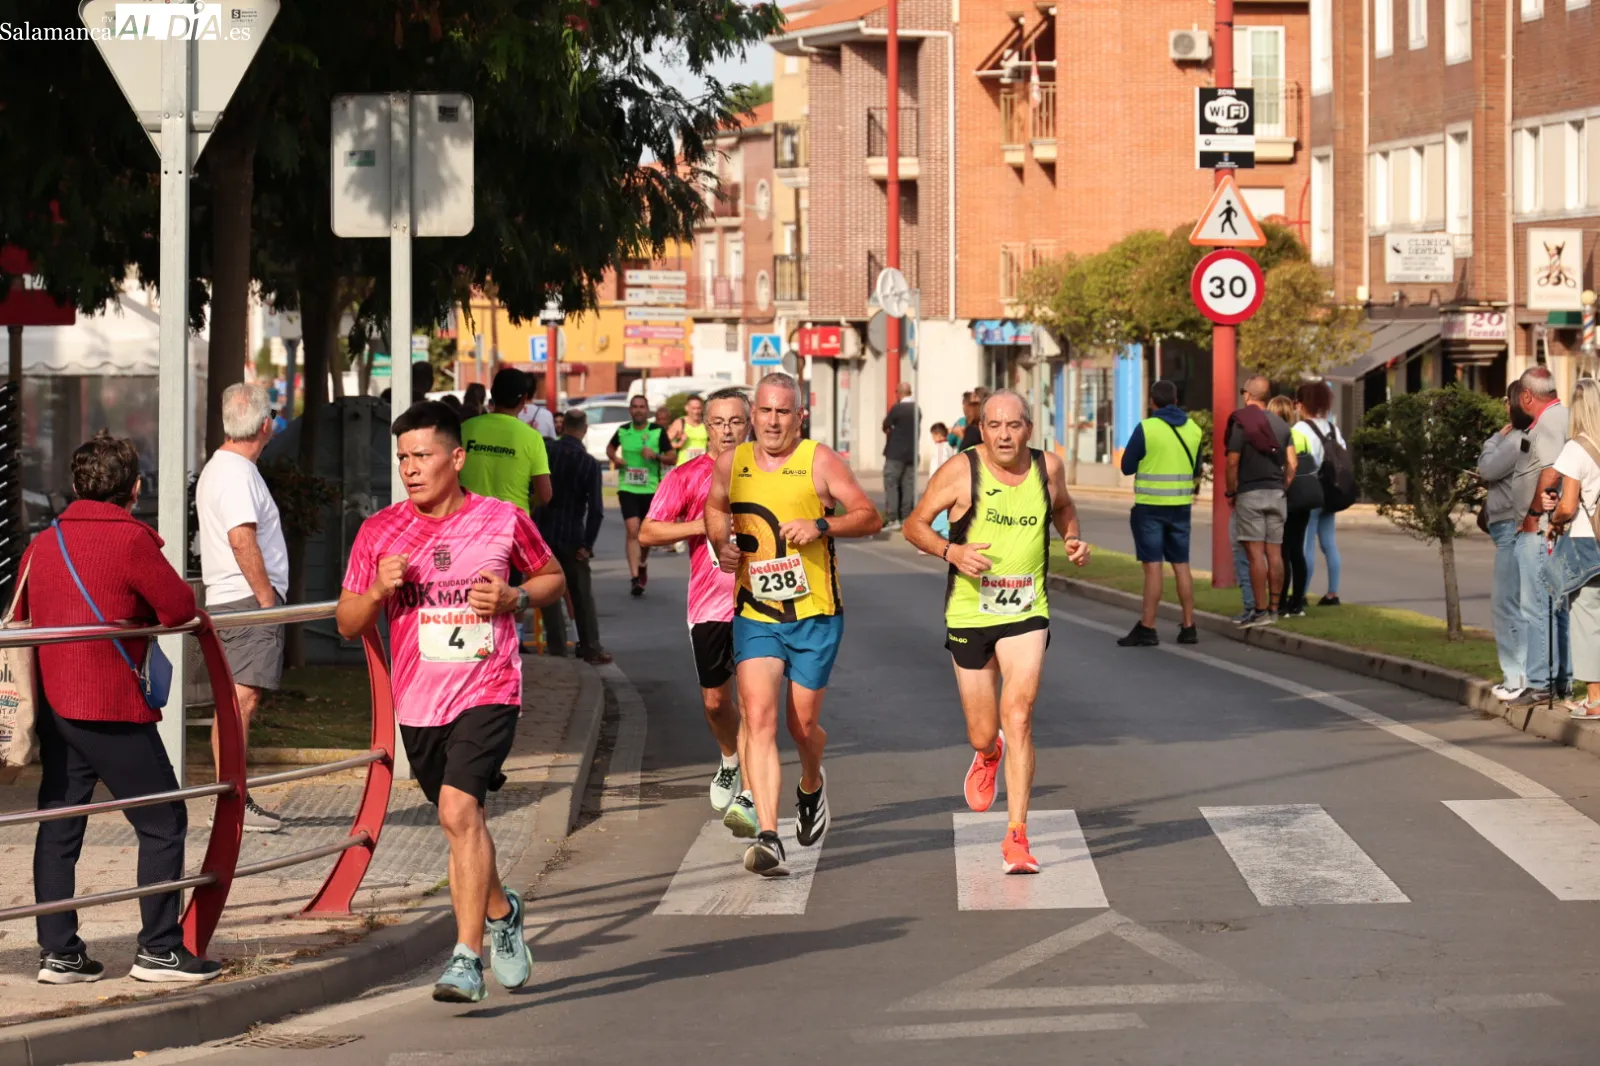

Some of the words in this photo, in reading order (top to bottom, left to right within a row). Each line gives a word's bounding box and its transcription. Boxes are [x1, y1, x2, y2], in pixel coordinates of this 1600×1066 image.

[1209, 275, 1247, 298] 30
[1472, 312, 1503, 327] 20
[751, 558, 801, 576] bedunia
[759, 570, 797, 593] 238
[995, 589, 1021, 606] 44
[449, 626, 465, 649] 4
